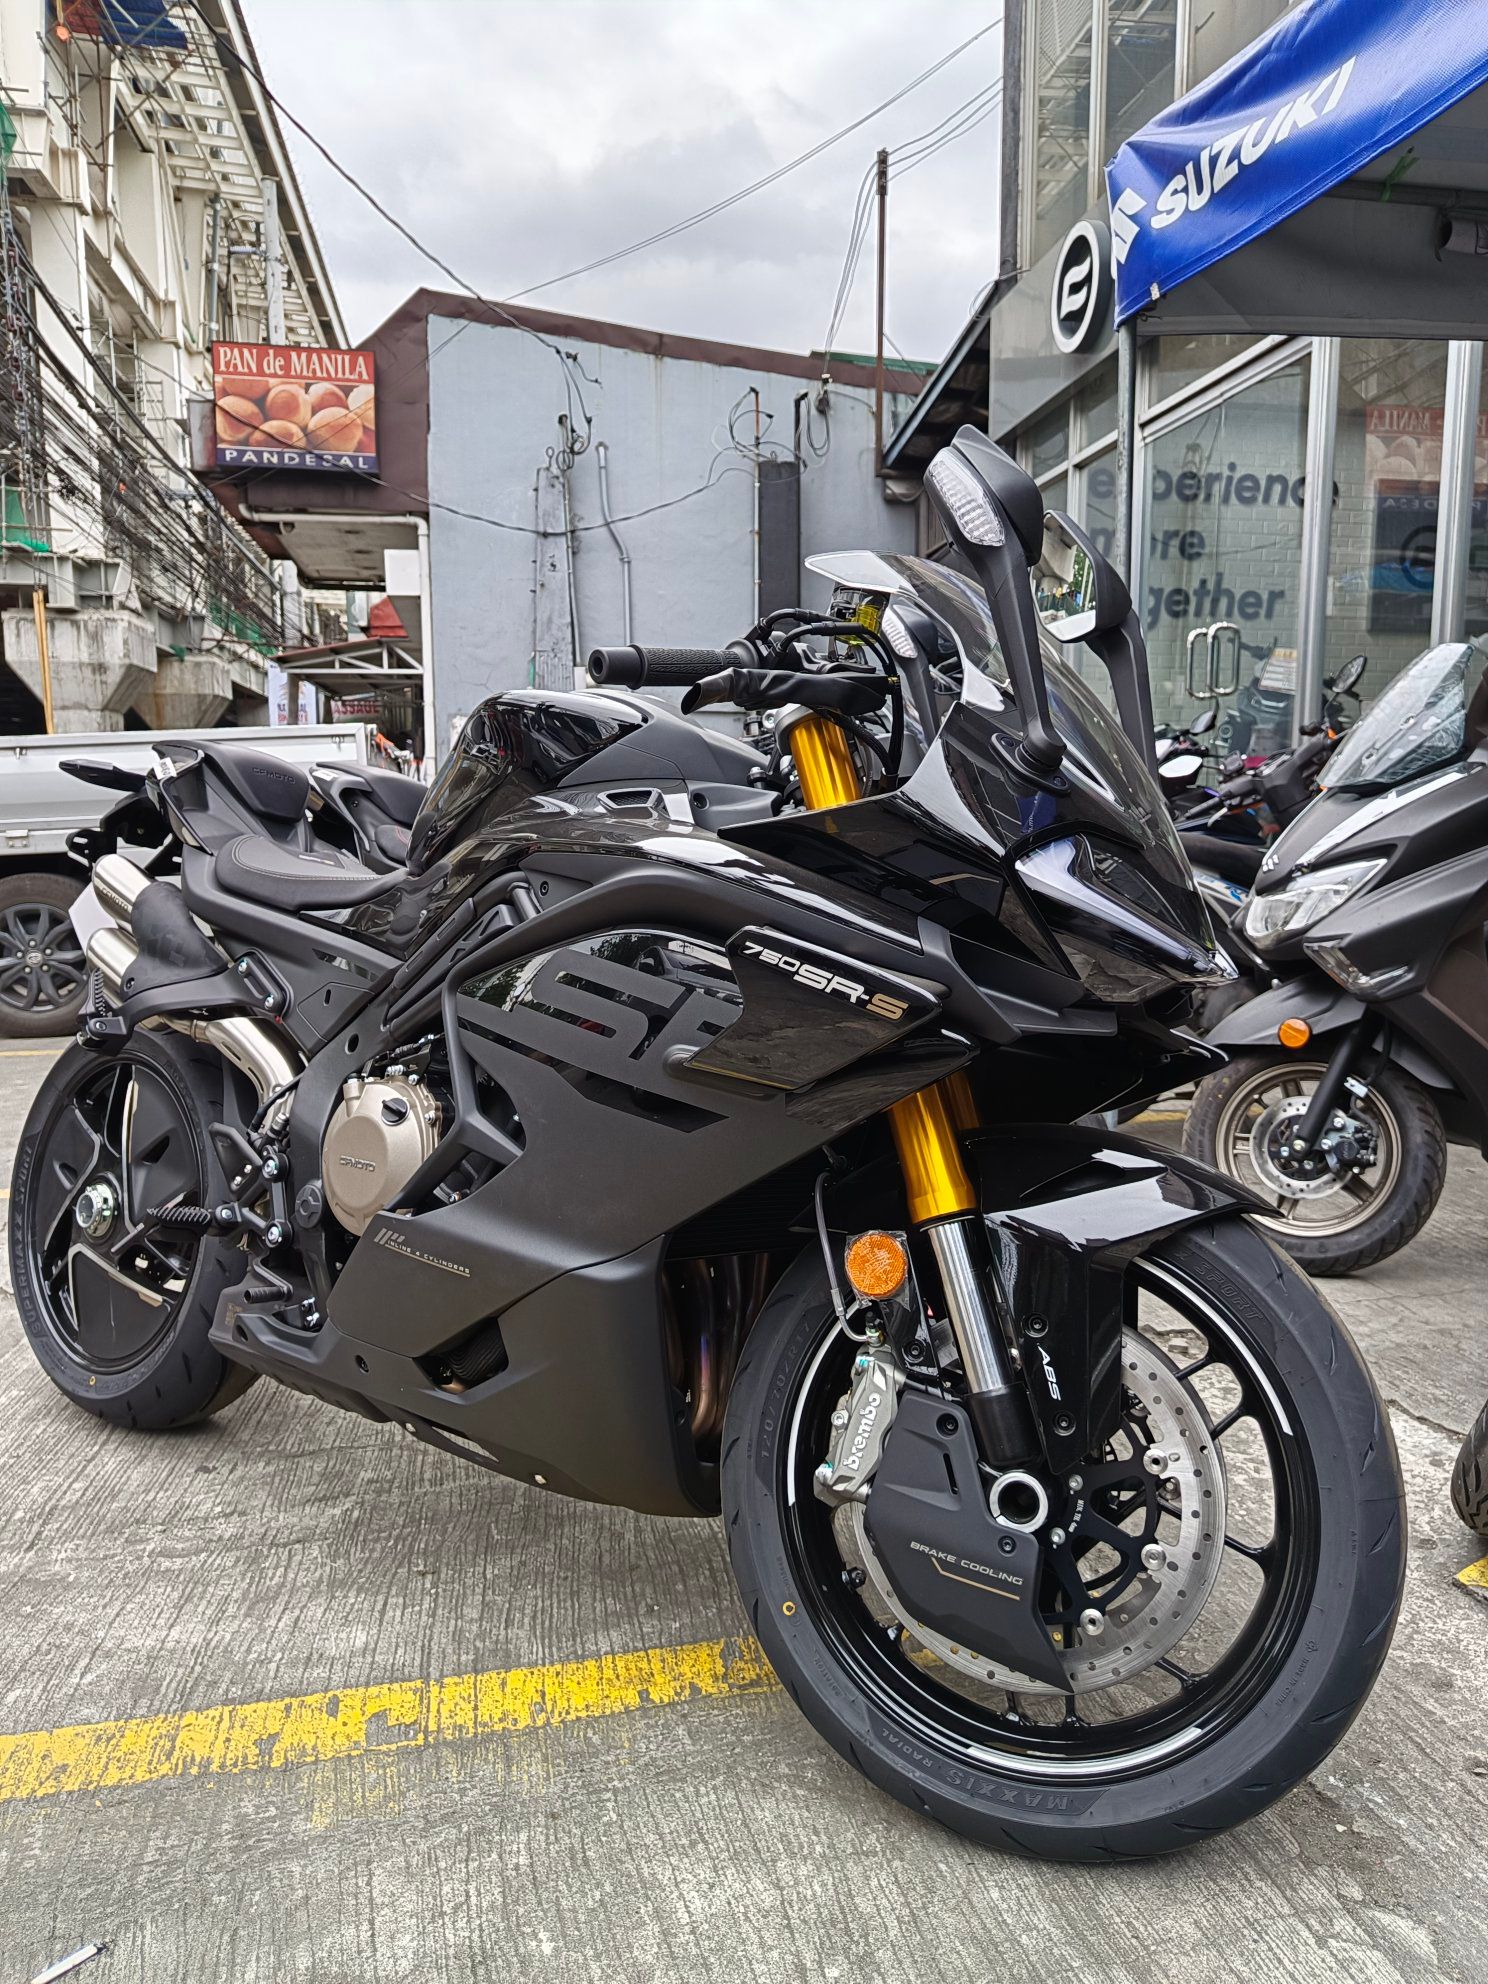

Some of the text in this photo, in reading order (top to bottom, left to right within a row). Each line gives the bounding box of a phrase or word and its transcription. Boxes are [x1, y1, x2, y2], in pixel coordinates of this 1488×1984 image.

[1150, 55, 1357, 230] SUZUKI
[218, 346, 369, 380] PAN de MANILA
[225, 450, 369, 469] PANDESAL
[387, 1240, 412, 1253] INLINE
[423, 1253, 471, 1274] CYLINDERS
[1036, 1343, 1062, 1401] ABS
[843, 1393, 881, 1471] brembo
[910, 1541, 1024, 1586] BRAKE COOLING
[881, 1727, 1071, 1811] MAXXIS RADIAL
